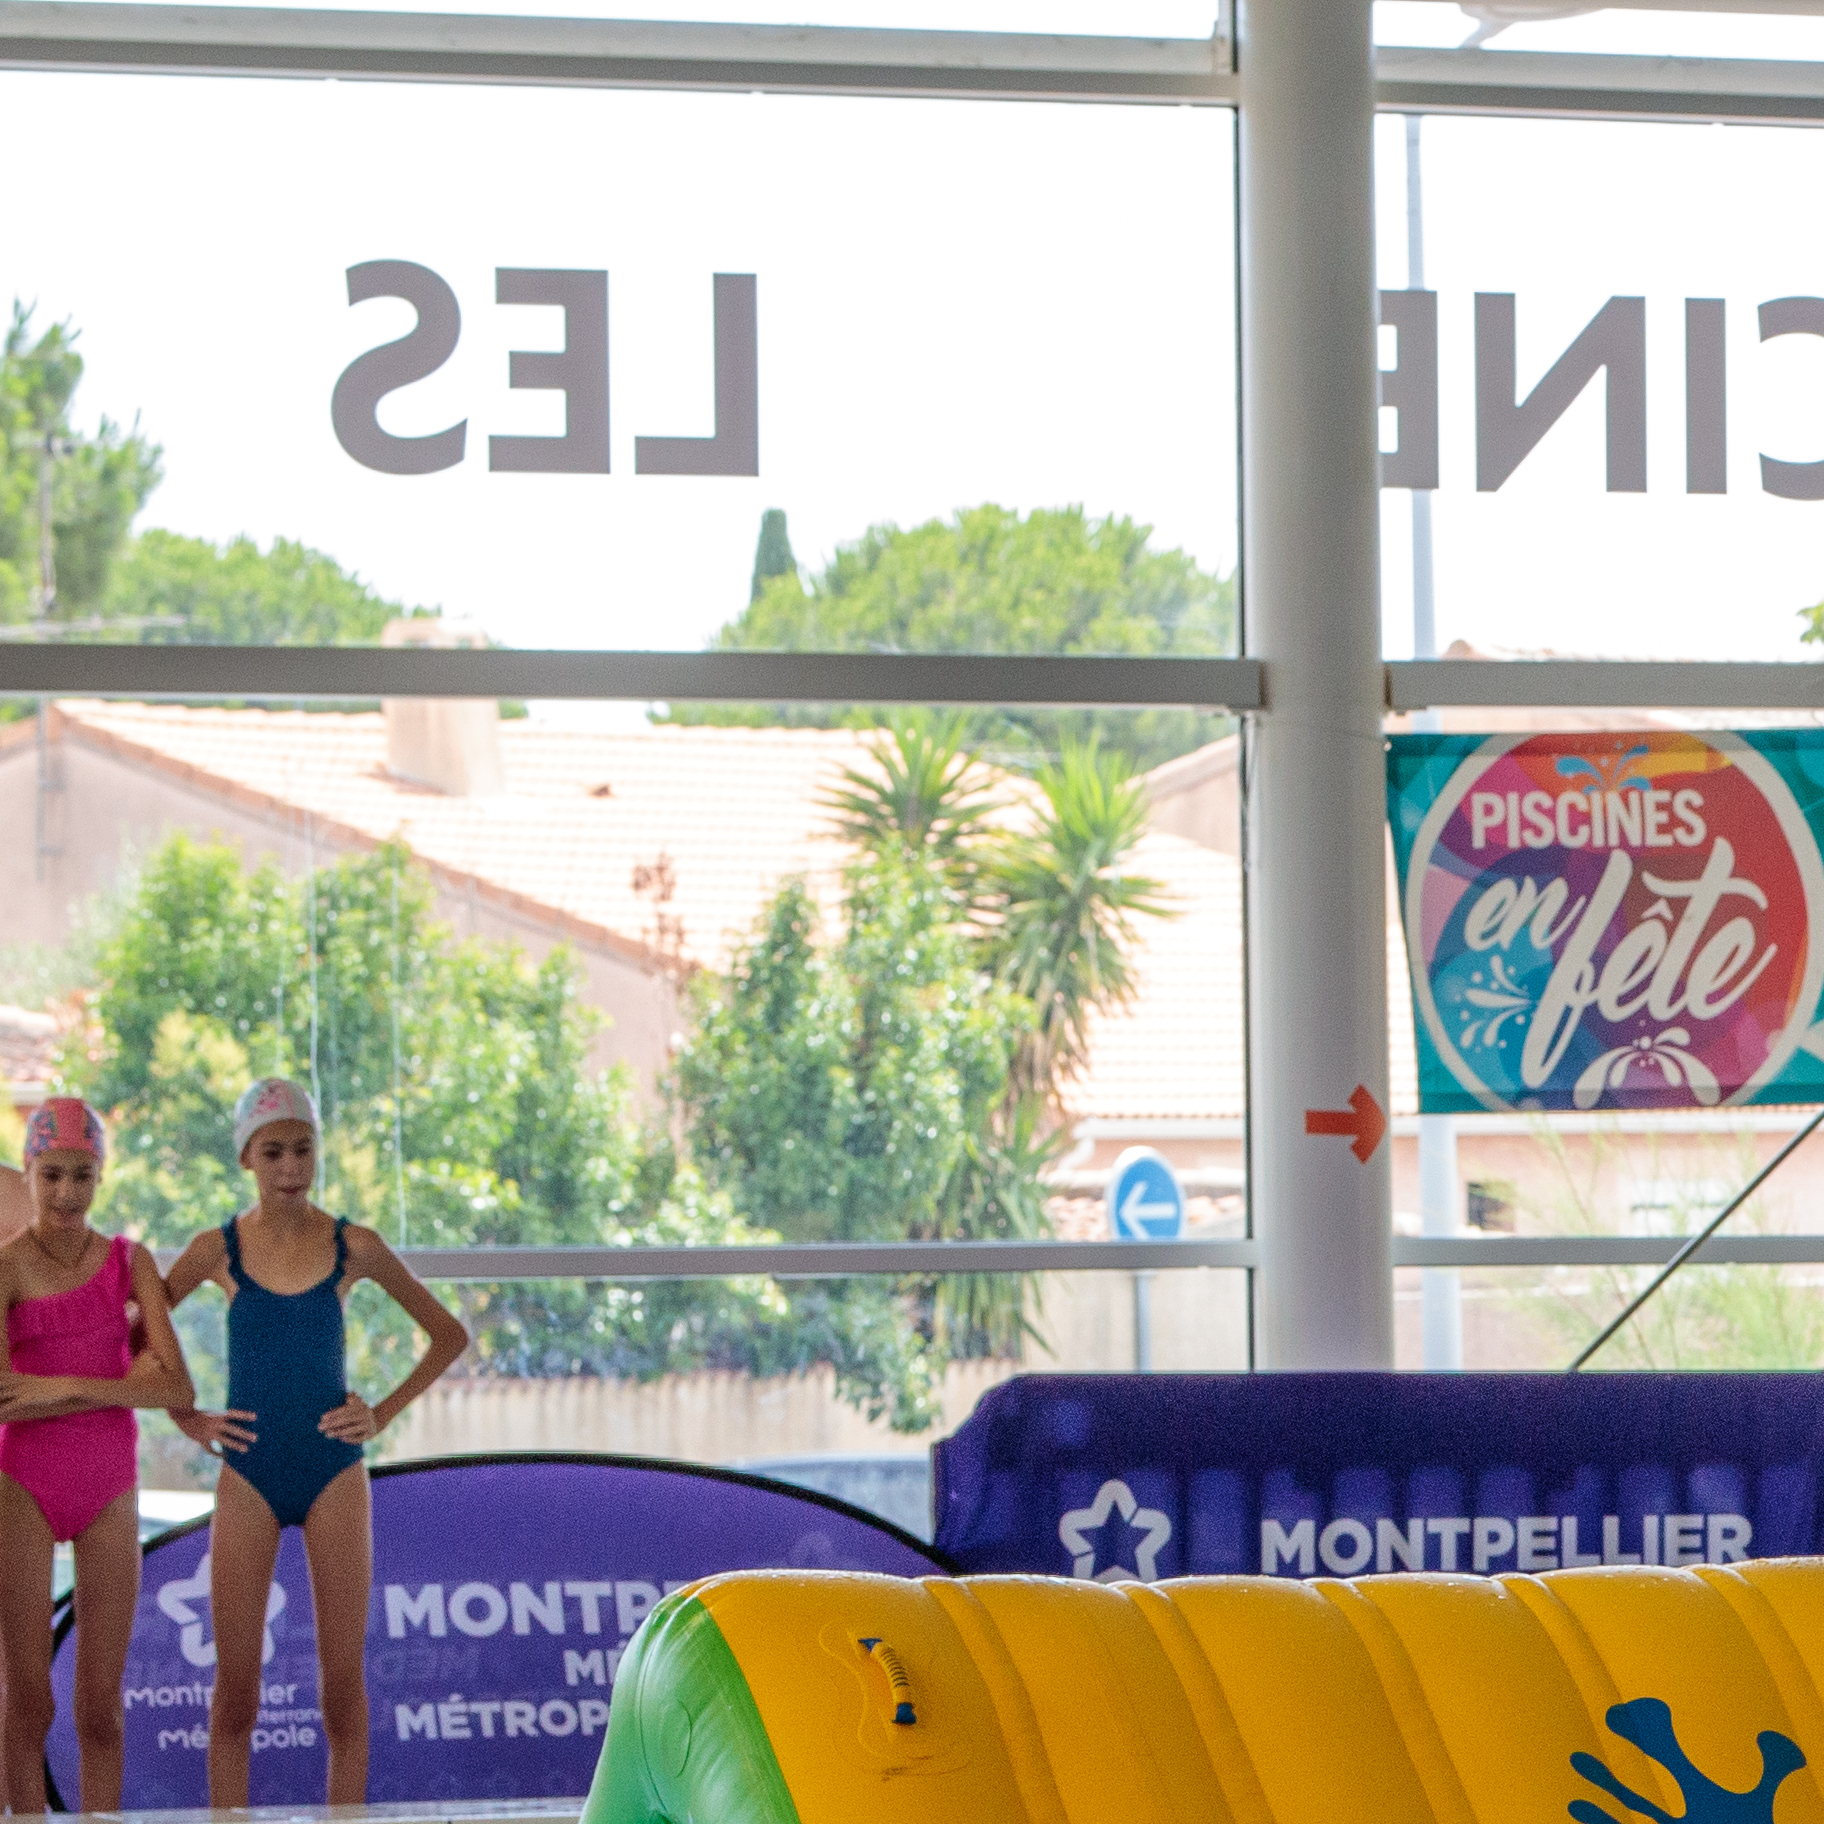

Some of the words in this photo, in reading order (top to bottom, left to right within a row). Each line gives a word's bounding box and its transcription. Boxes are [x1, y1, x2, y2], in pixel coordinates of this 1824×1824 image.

[1471, 788, 1707, 850] PISCINES
[1463, 875, 1586, 952] en
[1521, 836, 1778, 1089] fête
[1260, 1513, 1754, 1575] MONTPELLIER
[394, 1692, 612, 1742] MÉTROP
